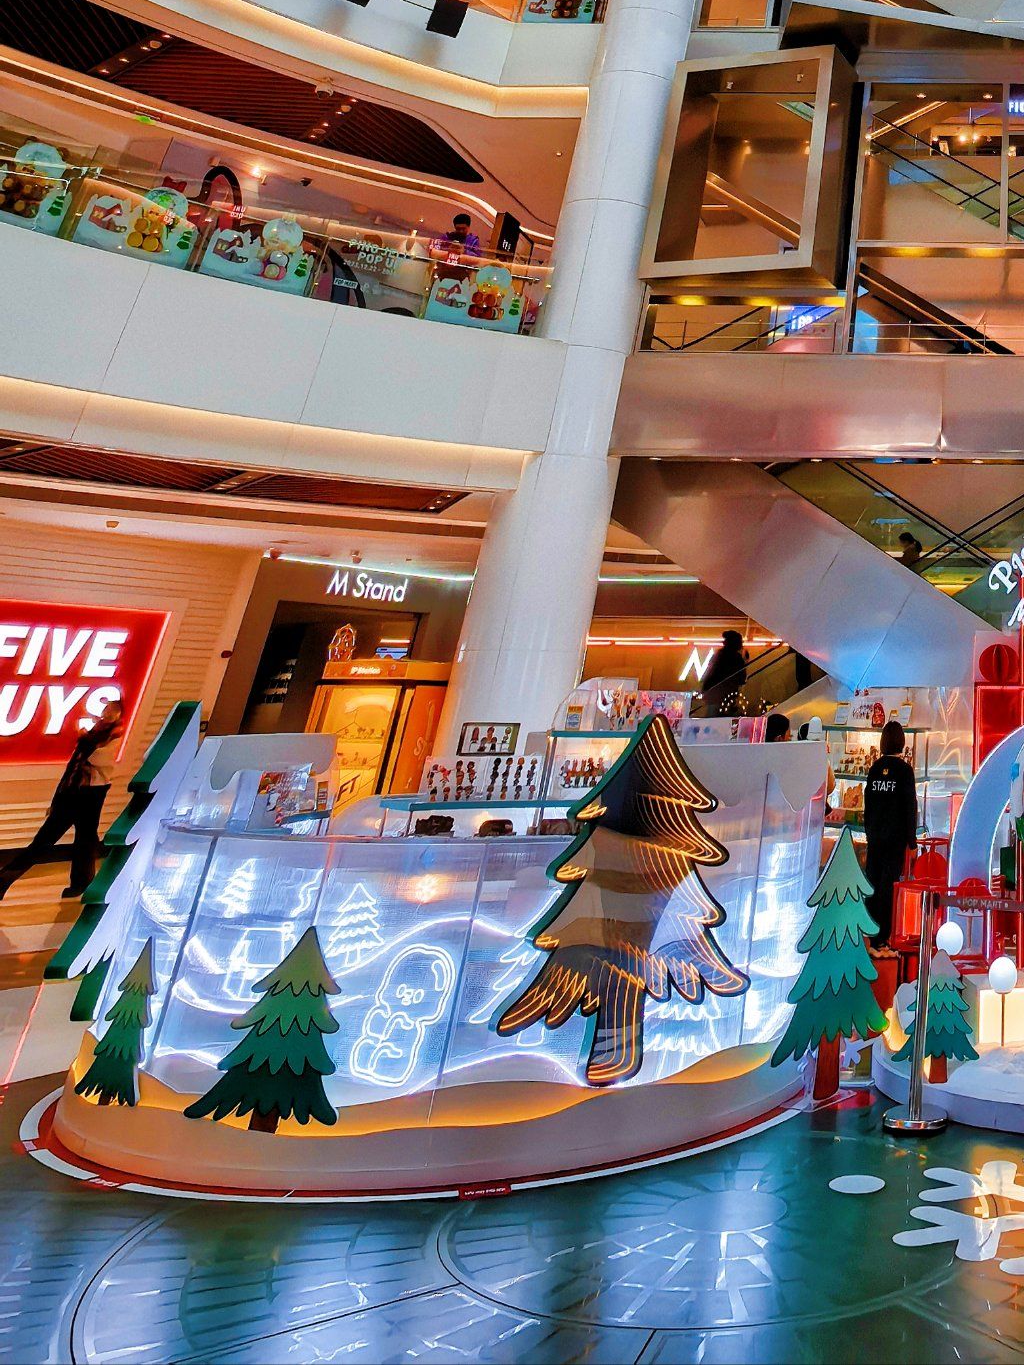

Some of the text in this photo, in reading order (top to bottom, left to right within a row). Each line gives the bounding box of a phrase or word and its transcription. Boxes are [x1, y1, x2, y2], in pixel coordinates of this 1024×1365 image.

[326, 569, 408, 603] M Stand
[0, 624, 129, 678] FIVE
[872, 780, 897, 792] STAFF
